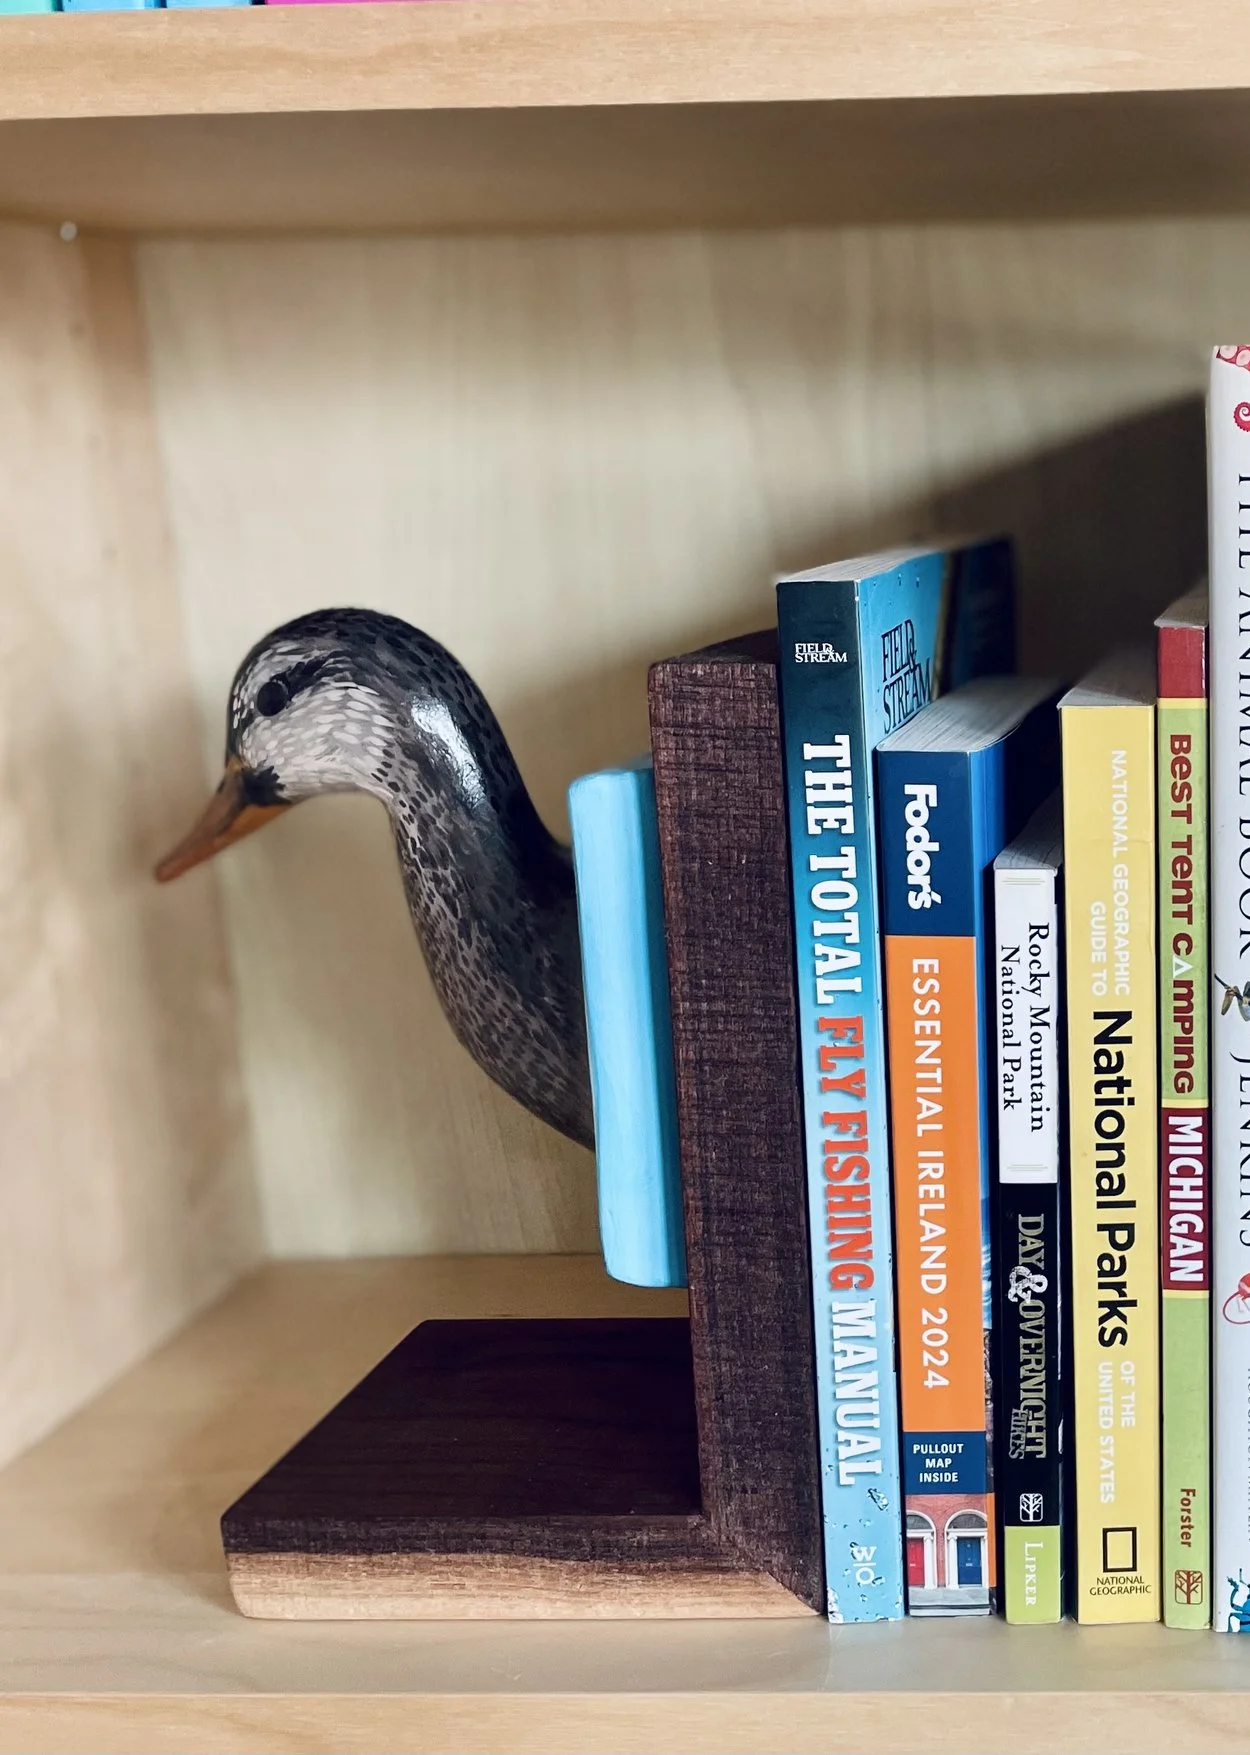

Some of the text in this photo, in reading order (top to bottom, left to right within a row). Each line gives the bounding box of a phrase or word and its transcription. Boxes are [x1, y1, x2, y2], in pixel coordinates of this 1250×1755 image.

[795, 643, 832, 653] FIELD
[795, 652, 847, 663] STREAM
[881, 619, 914, 682] FIELD
[883, 658, 931, 734] STREAM
[904, 784, 942, 911] Fodor's
[1111, 750, 1131, 996] NATIONAL GEOGRAPHIC
[1091, 901, 1108, 997] GUIDE TO
[1001, 945, 1022, 1111] National Park
[1021, 922, 1051, 1132] Rocky Mountain
[803, 734, 883, 1486] THE TOTAL FLY FISHING MANUAL
[912, 958, 950, 1388] ESSENTIAL IRELAND 2024
[1093, 1010, 1138, 1348] National Parks
[1168, 1115, 1204, 1282] MICHIGAN
[1008, 1214, 1048, 1458] DAY & OVERNIGHT
[1120, 1361, 1136, 1427] OF THE
[913, 1444, 964, 1454] PULLOUT
[925, 1458, 952, 1468] MAP
[1009, 1408, 1028, 1459] HIKES
[1098, 1362, 1115, 1504] UNITED STATES
[920, 1472, 958, 1483] INSIDE
[1180, 1488, 1196, 1548] Forster
[1090, 1585, 1152, 1596] GEOGRAPHIC
[1097, 1575, 1145, 1585] NATIONAL
